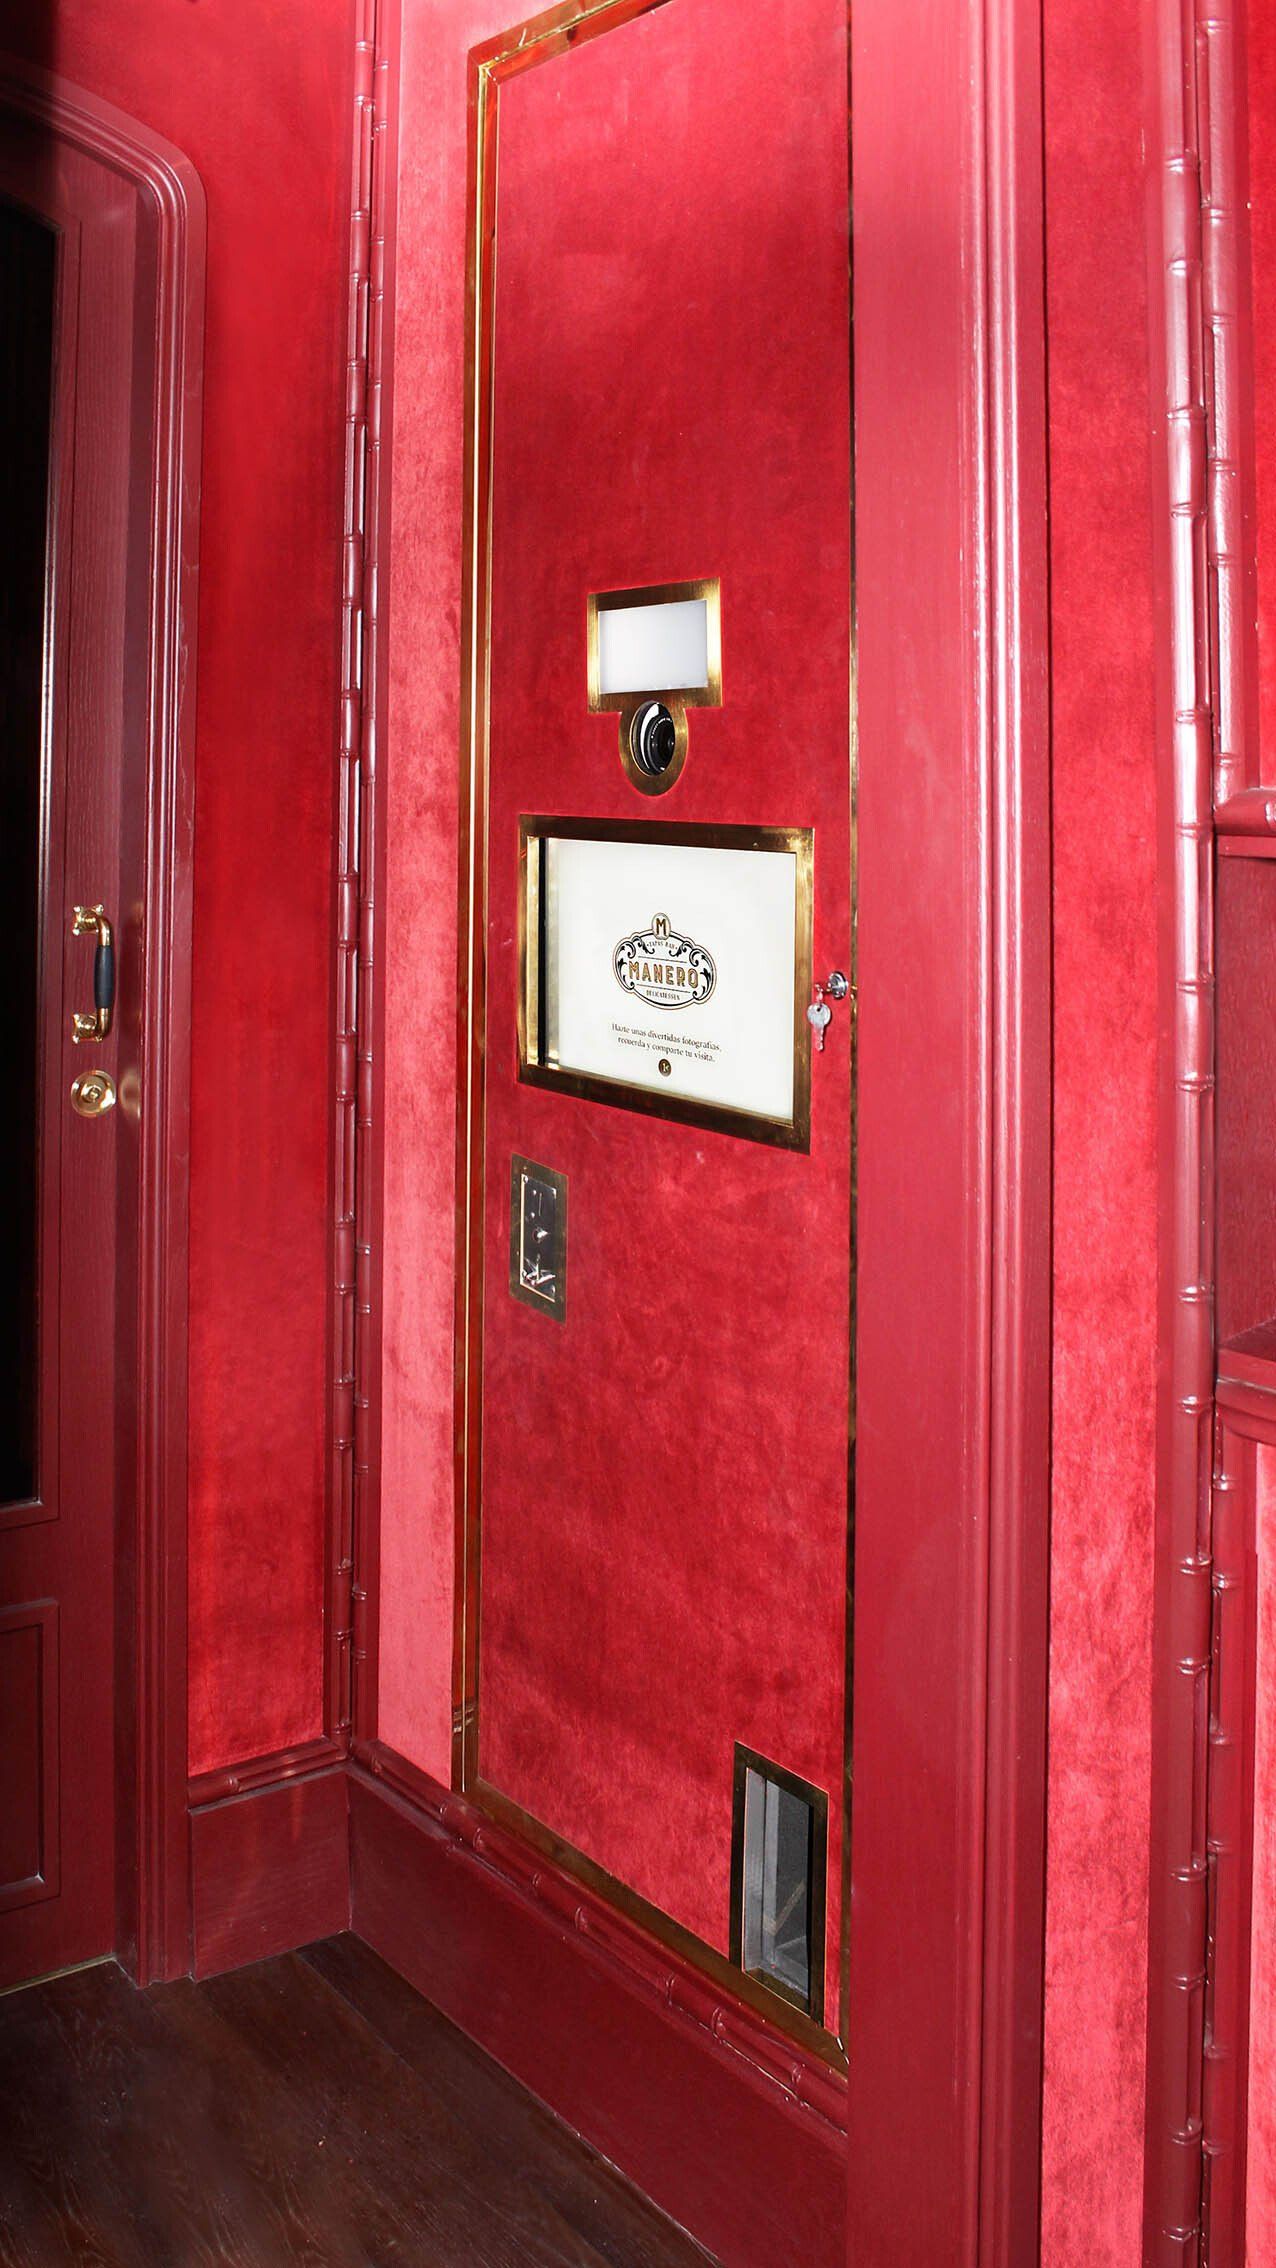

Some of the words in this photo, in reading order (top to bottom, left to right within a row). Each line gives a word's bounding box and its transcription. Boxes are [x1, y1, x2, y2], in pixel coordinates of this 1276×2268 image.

[628, 960, 699, 989] MANERO
[631, 1028, 647, 1036] unas
[648, 1029, 680, 1043] divertidas
[618, 1036, 645, 1047] recuerda
[652, 1043, 684, 1055] comparte
